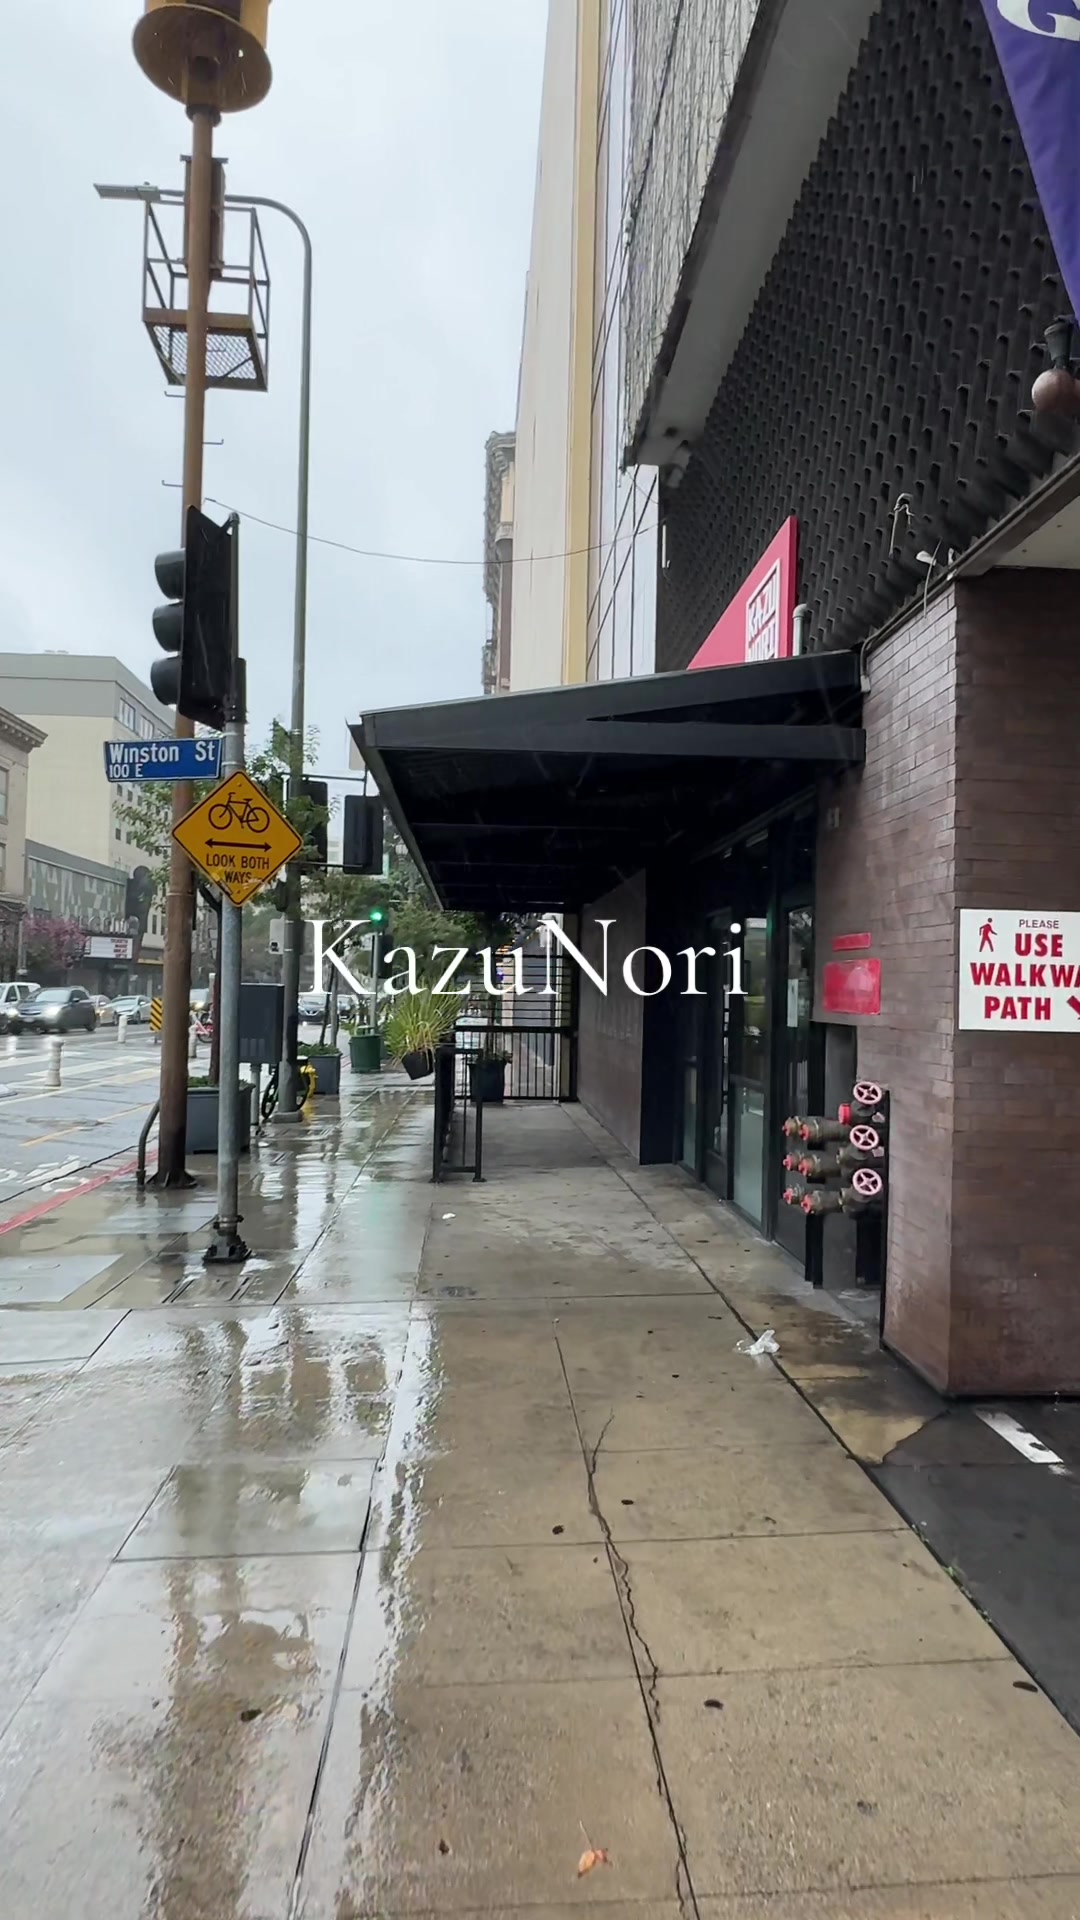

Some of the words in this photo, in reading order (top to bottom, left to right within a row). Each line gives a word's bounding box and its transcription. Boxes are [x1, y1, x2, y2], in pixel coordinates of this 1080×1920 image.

[748, 572, 777, 642] KAZU
[109, 743, 180, 763] Winston
[195, 741, 216, 761] St
[109, 764, 130, 778] 100
[135, 764, 143, 778] E
[206, 853, 236, 867] LOOK
[240, 856, 270, 870] BOTH
[224, 871, 252, 884] WAYS
[1018, 919, 1060, 929] PLEASE
[1015, 933, 1064, 957] USE
[984, 996, 1052, 1020] PATH
